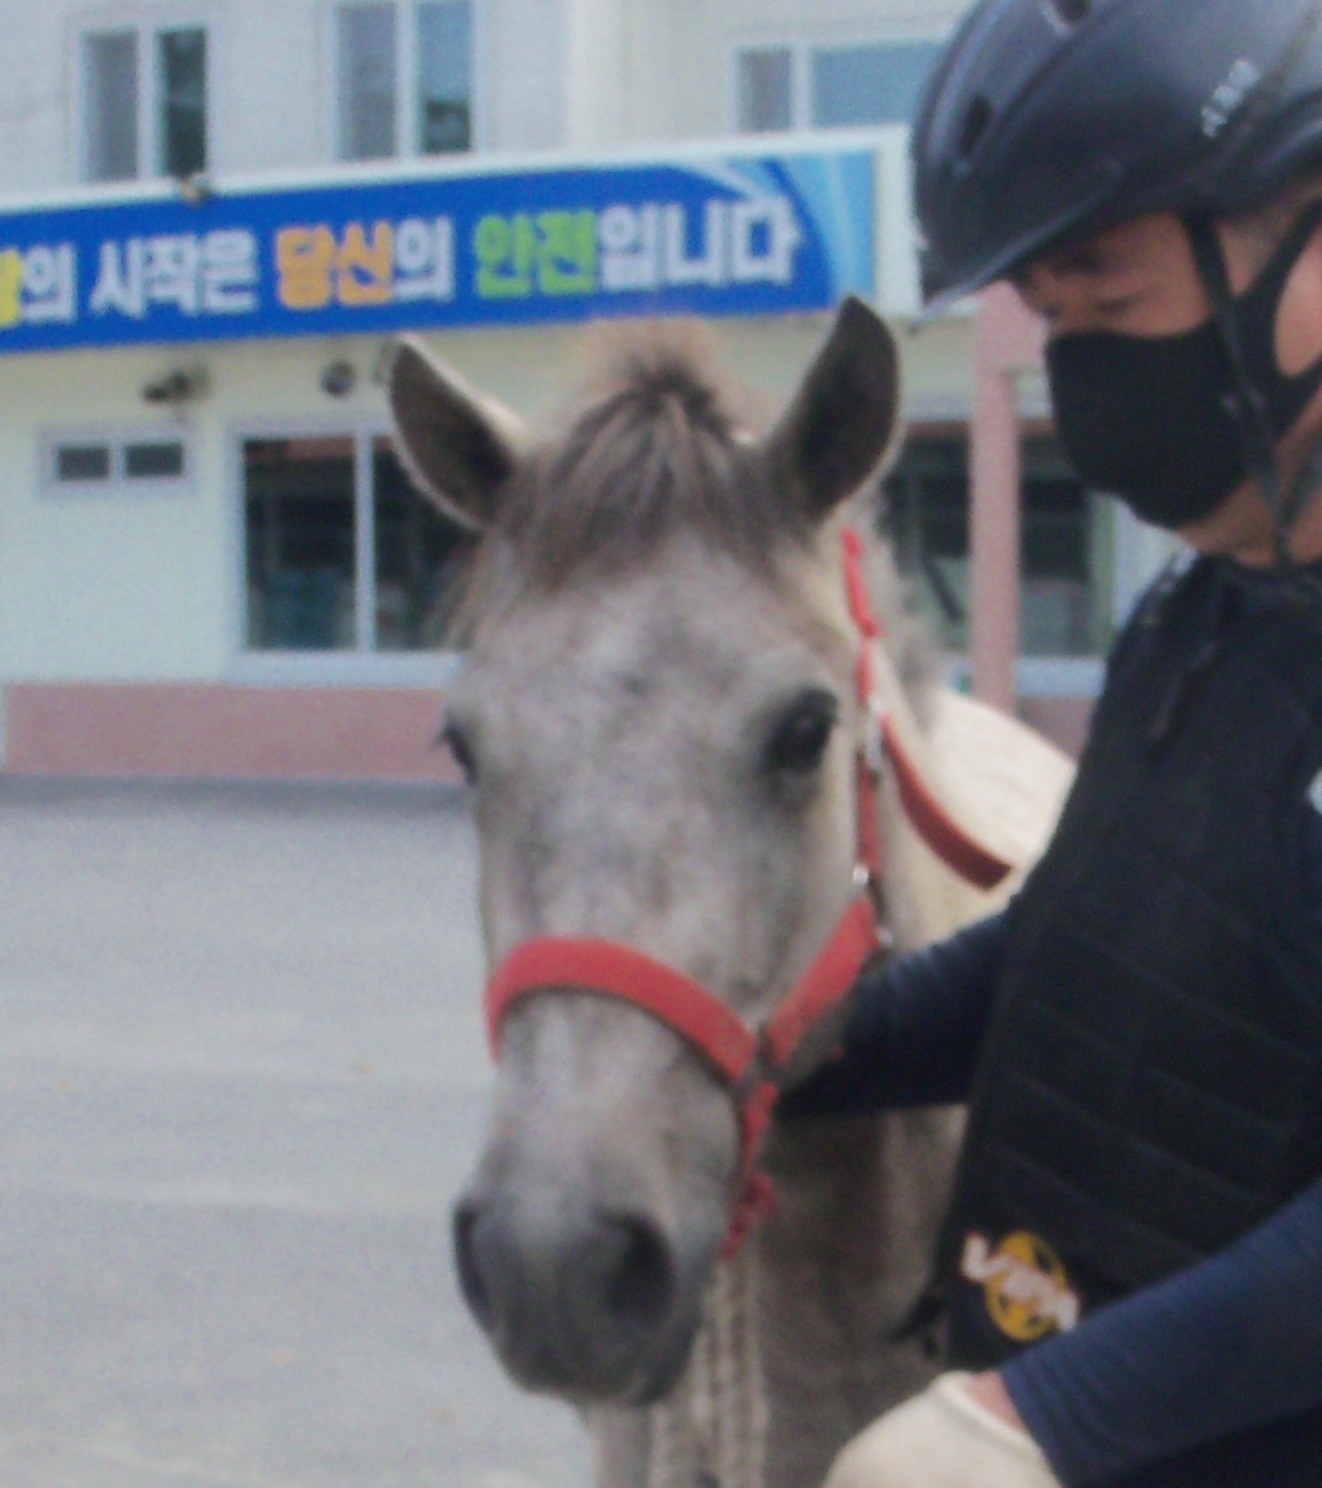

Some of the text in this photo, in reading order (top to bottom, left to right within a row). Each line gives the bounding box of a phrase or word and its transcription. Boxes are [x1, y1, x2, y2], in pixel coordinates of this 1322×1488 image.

[88, 229, 257, 319] 시작은
[276, 216, 454, 308] 당신의
[475, 200, 802, 298] 안전입니다
